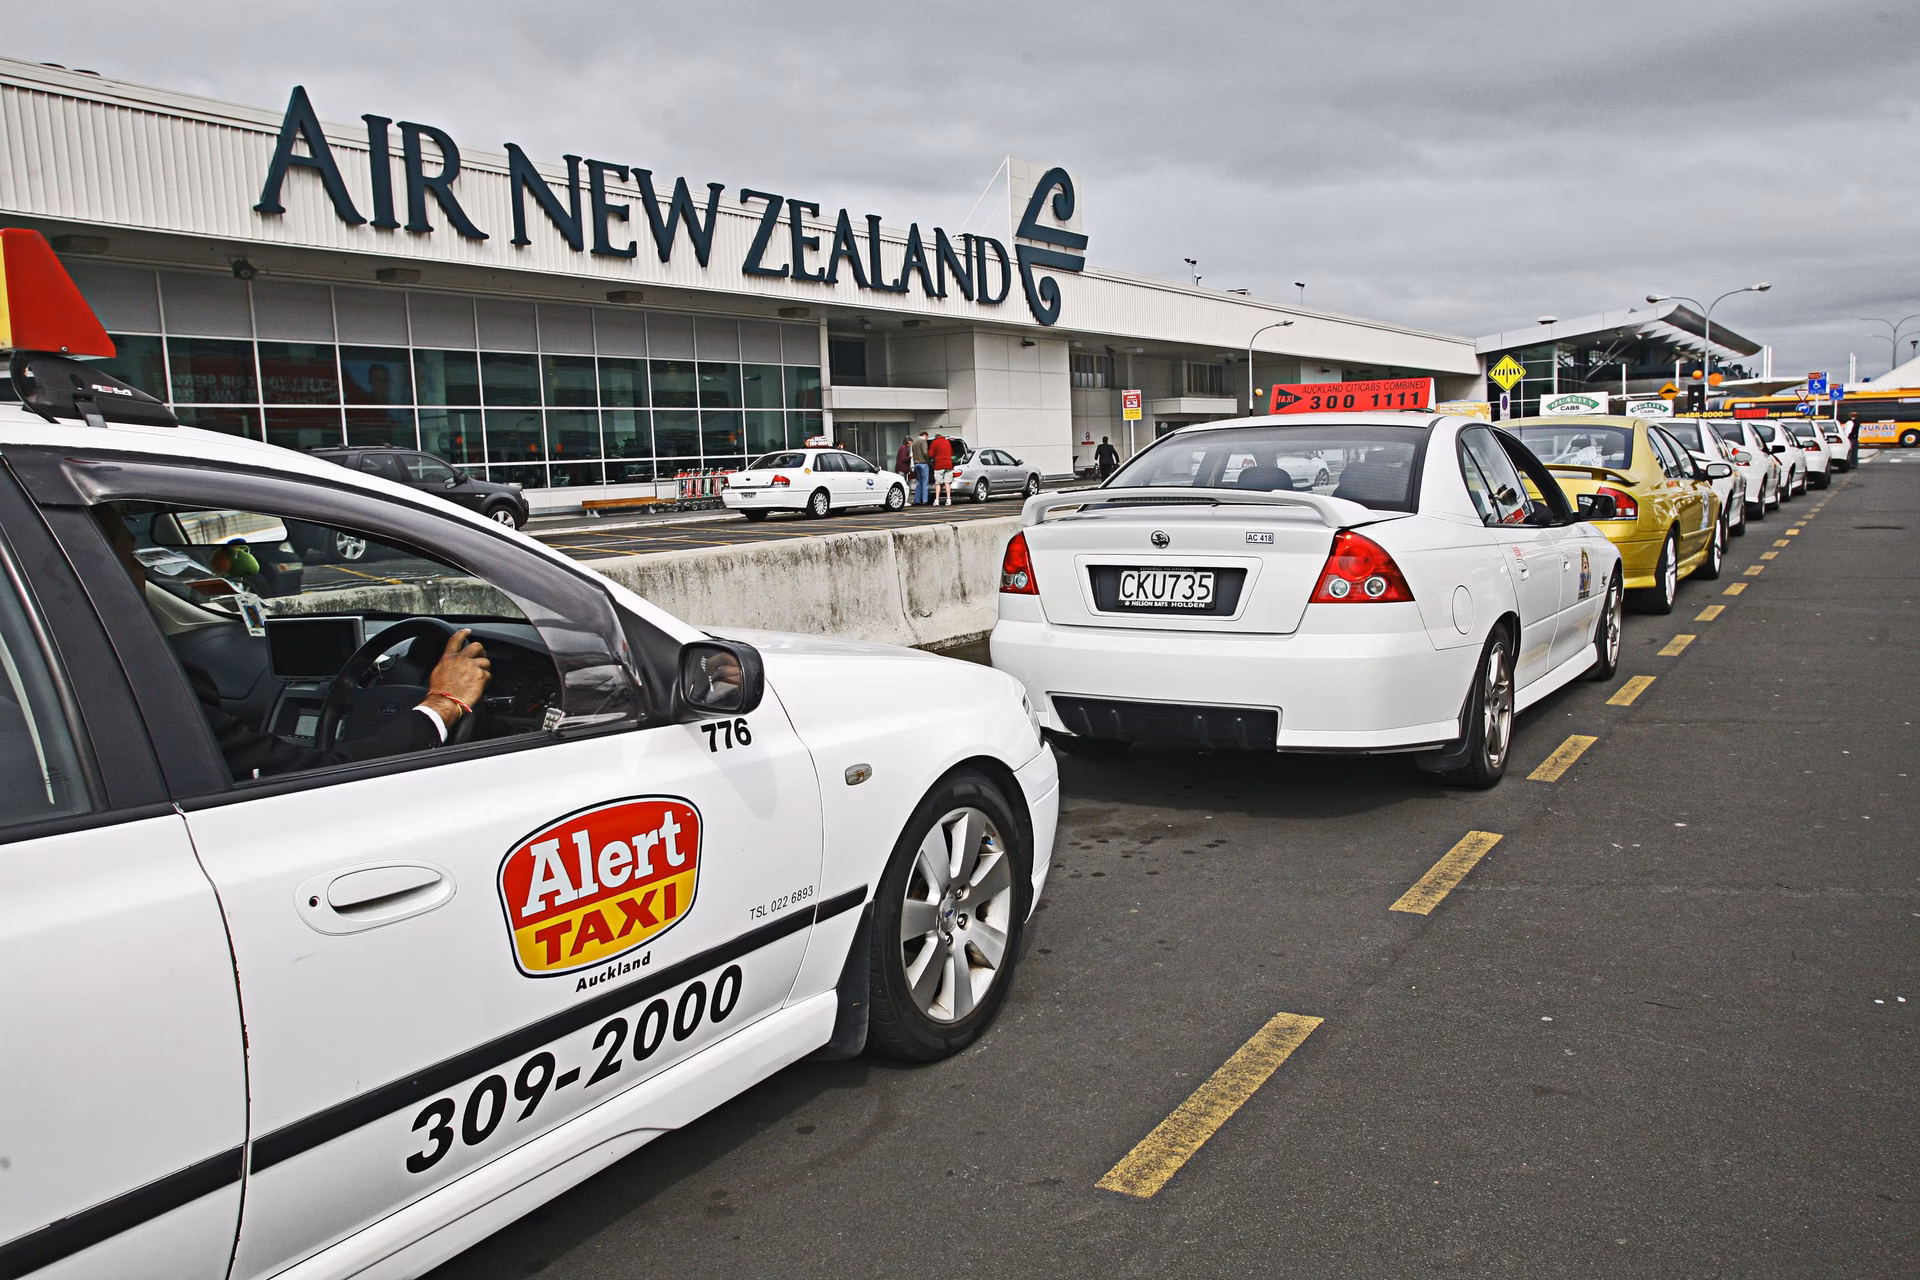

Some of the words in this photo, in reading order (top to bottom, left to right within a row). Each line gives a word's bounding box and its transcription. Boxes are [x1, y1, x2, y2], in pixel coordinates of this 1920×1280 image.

[253, 85, 489, 240] AIR
[503, 142, 725, 268] NEW
[739, 187, 1011, 305] ZEALAND
[1278, 395, 1295, 403] TAXI
[1302, 385, 1343, 395] AUCKLAND
[1345, 382, 1381, 393] CITICABS
[1384, 381, 1426, 391] COMBINED
[1309, 394, 1355, 410] 300
[1371, 391, 1419, 407] 1111
[1551, 396, 1595, 408] QUALITY
[1632, 403, 1666, 411] QUALITY
[1247, 534, 1258, 542] AC
[1260, 534, 1273, 542] 418
[1121, 573, 1212, 600] CKU735
[701, 717, 753, 753] 776
[521, 810, 686, 918] Alert
[750, 904, 768, 921] TSL
[771, 895, 789, 912] 022
[791, 885, 813, 904] 6893
[535, 883, 677, 966] TAXI
[575, 951, 651, 993] Auckland
[406, 964, 743, 1174] 309-2000
